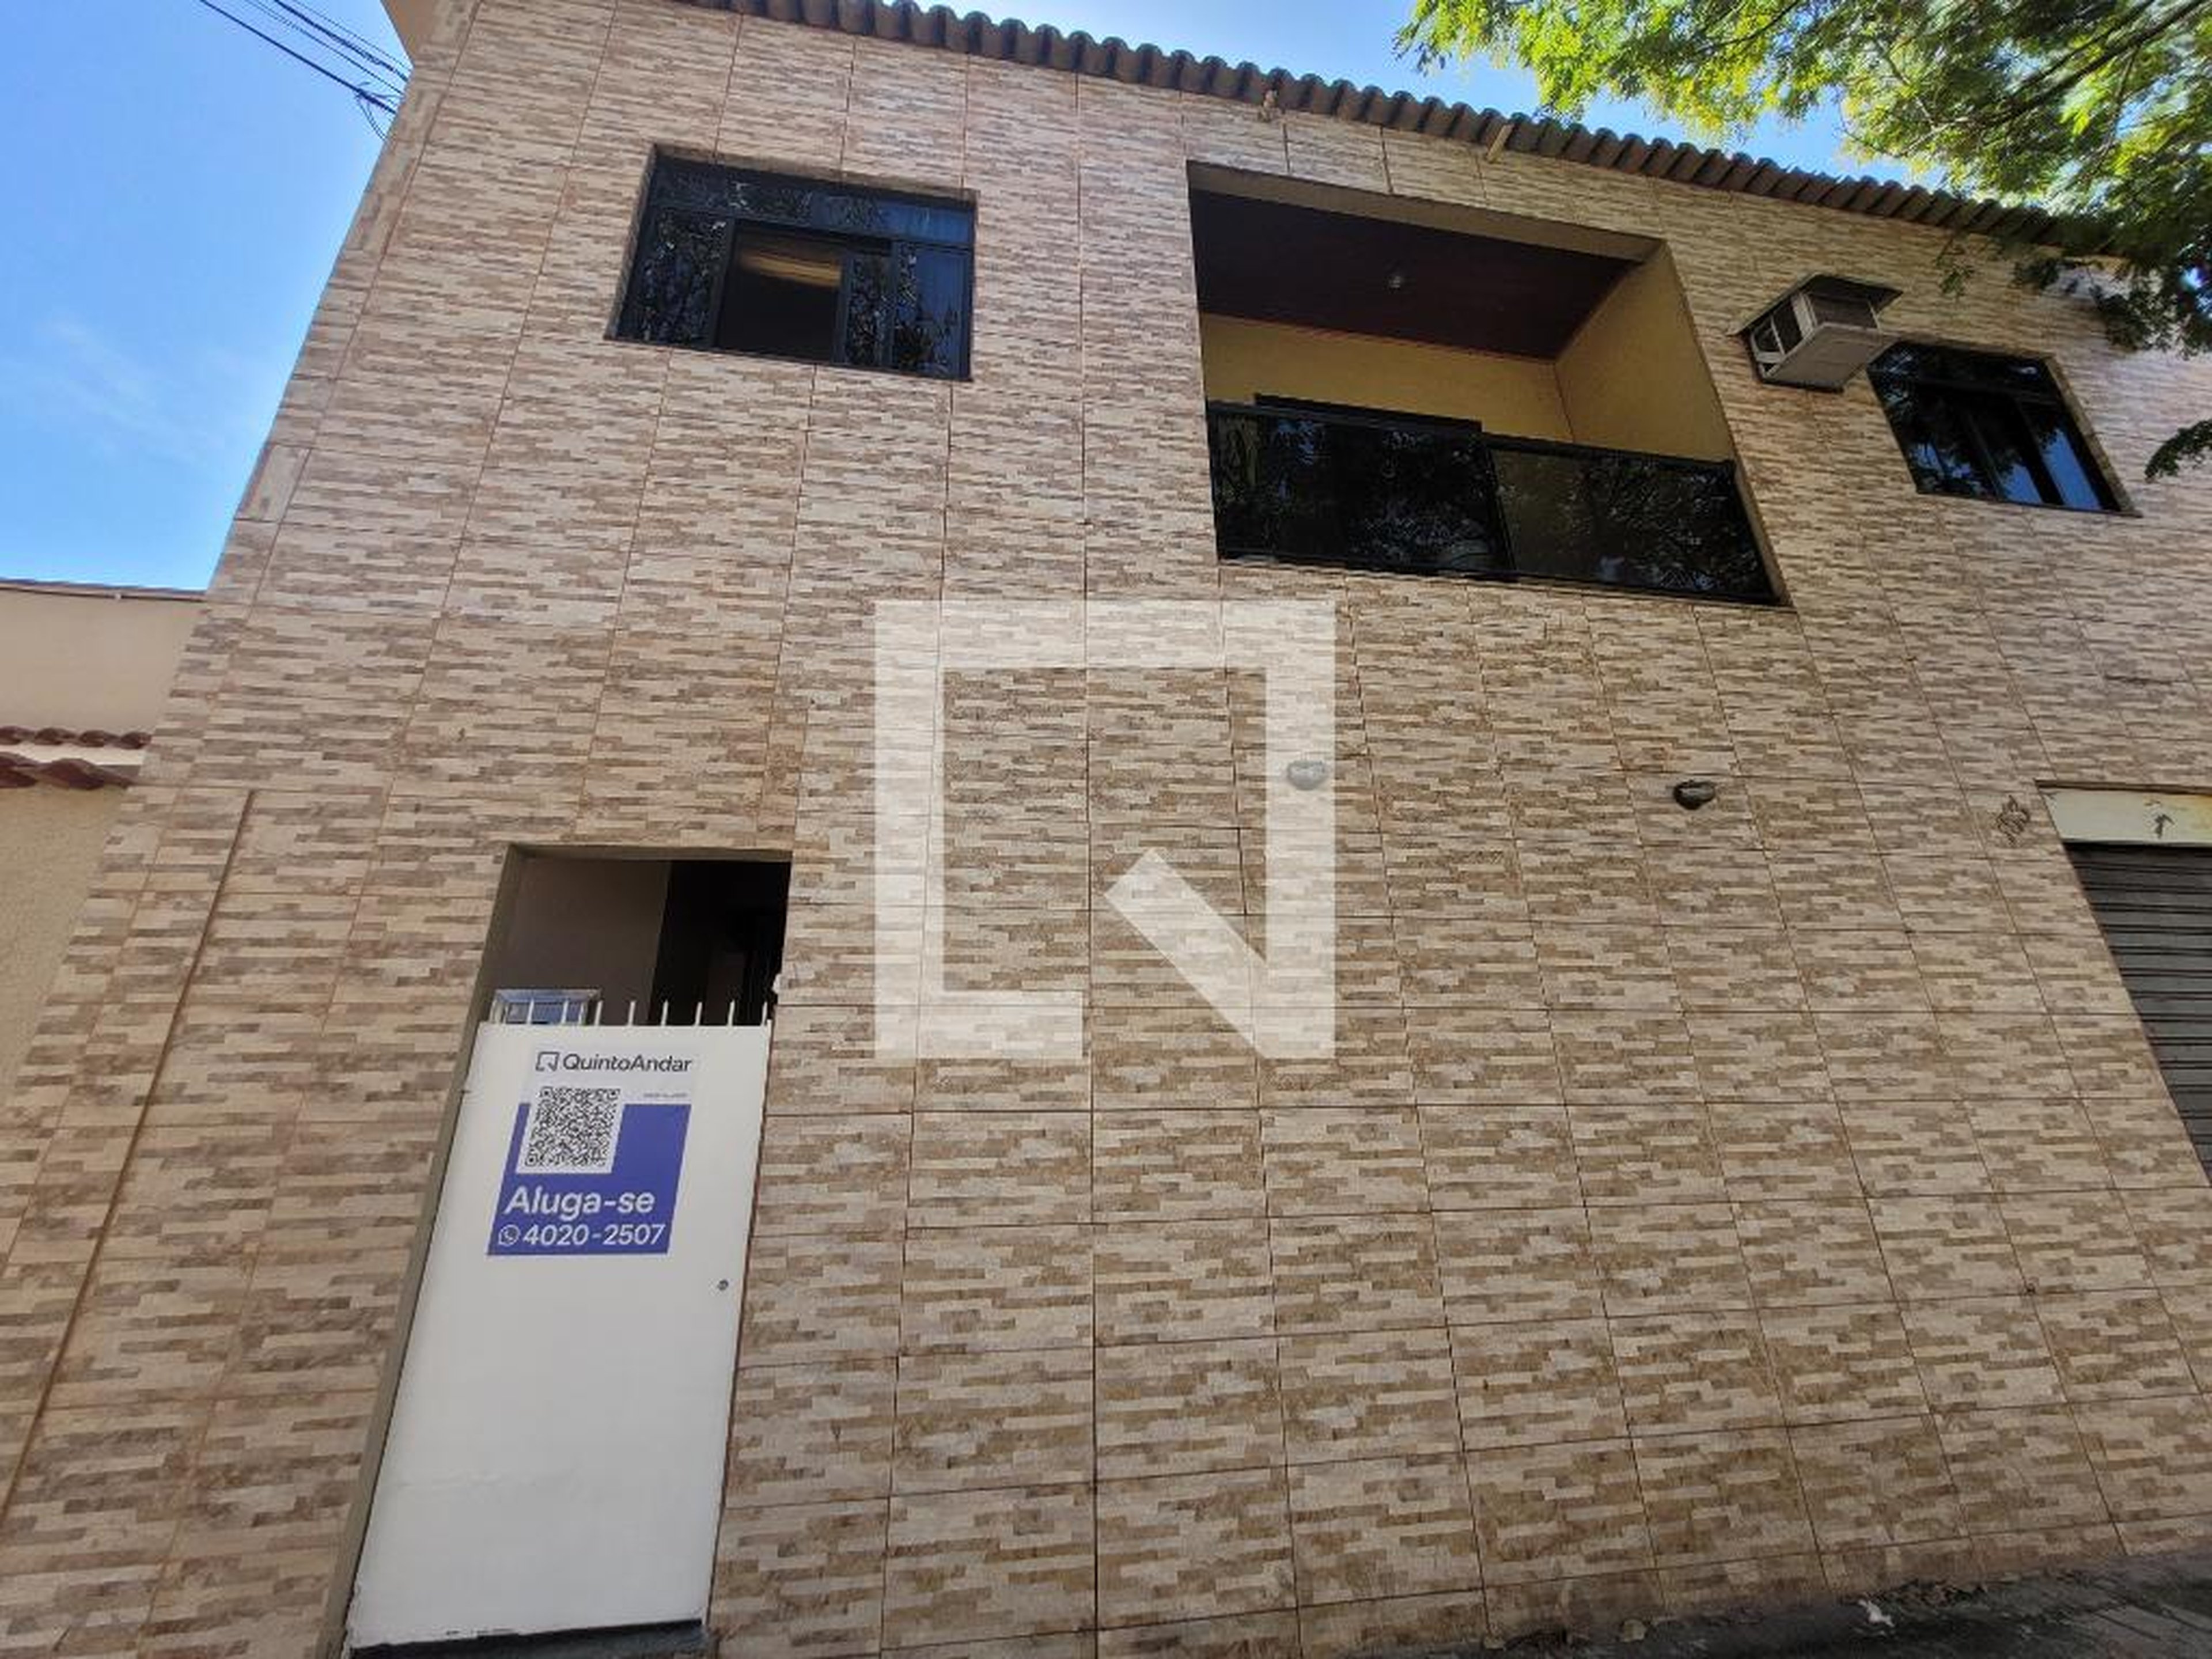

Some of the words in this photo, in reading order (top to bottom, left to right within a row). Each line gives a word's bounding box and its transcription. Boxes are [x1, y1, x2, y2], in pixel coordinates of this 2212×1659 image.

[563, 1053, 692, 1072] QuintoAndar
[504, 1185, 655, 1221] Aluga-se
[522, 1224, 665, 1245] 4020-2507
